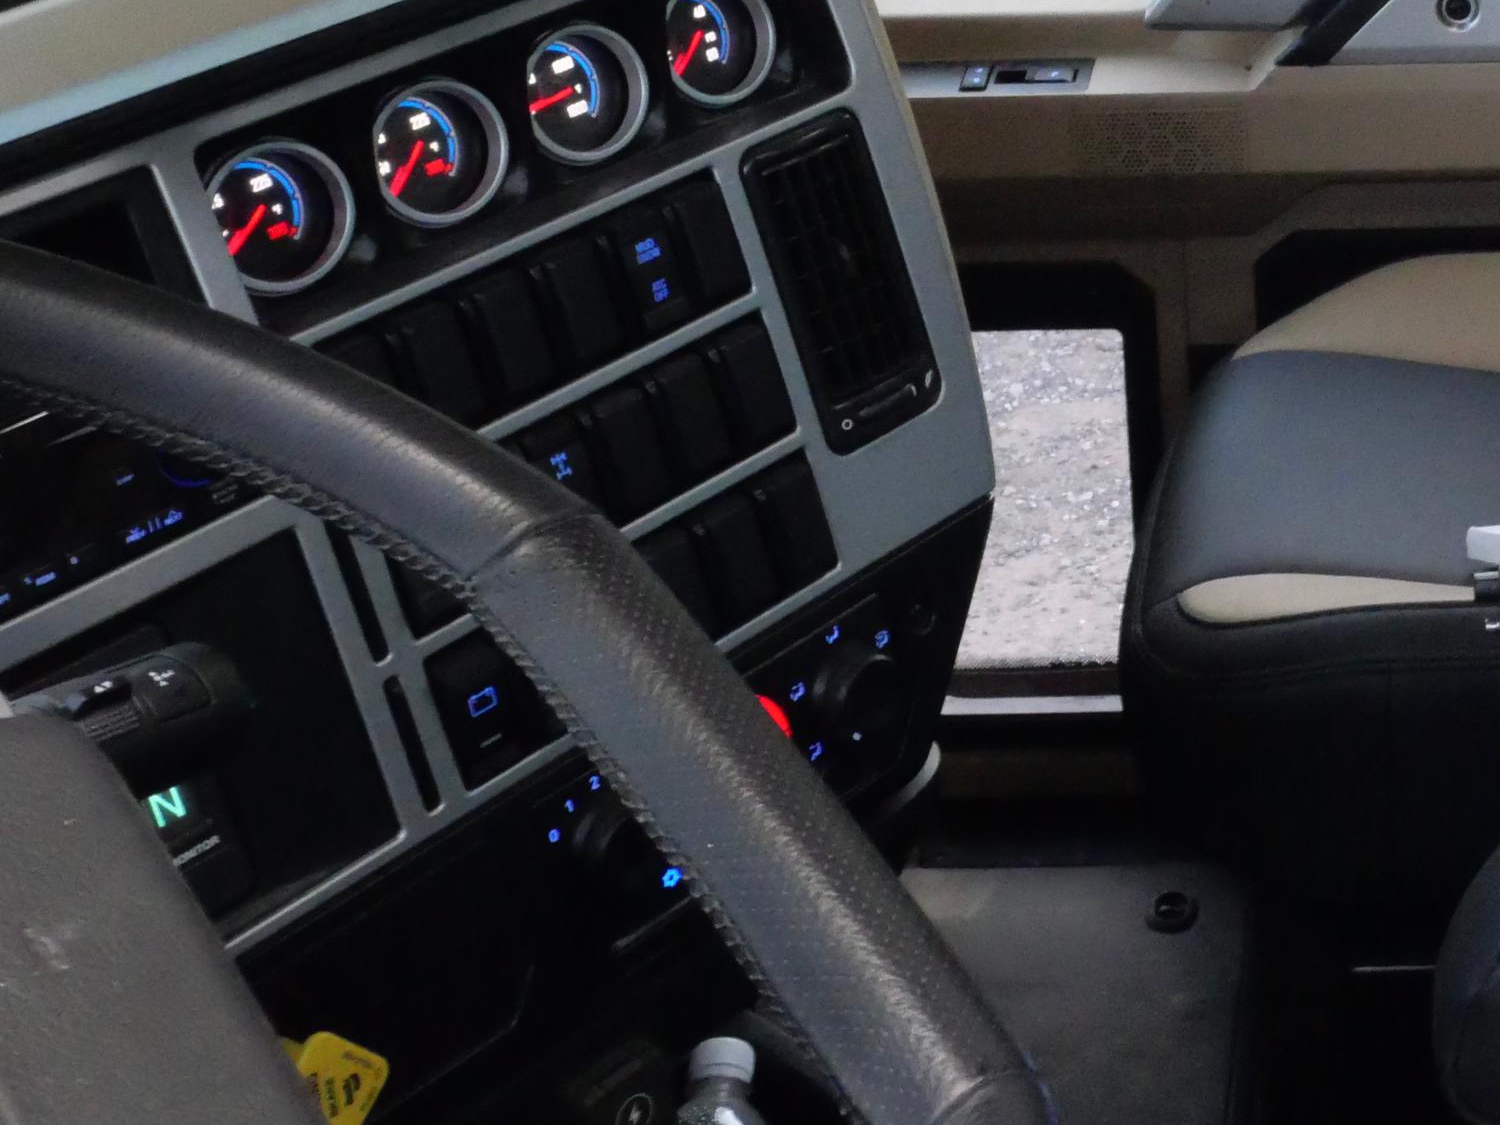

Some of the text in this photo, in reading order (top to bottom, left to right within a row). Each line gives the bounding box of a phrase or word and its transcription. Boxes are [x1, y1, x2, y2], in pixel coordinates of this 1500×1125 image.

[588, 775, 601, 791] 2
[148, 786, 187, 828] N
[564, 799, 575, 813] 1
